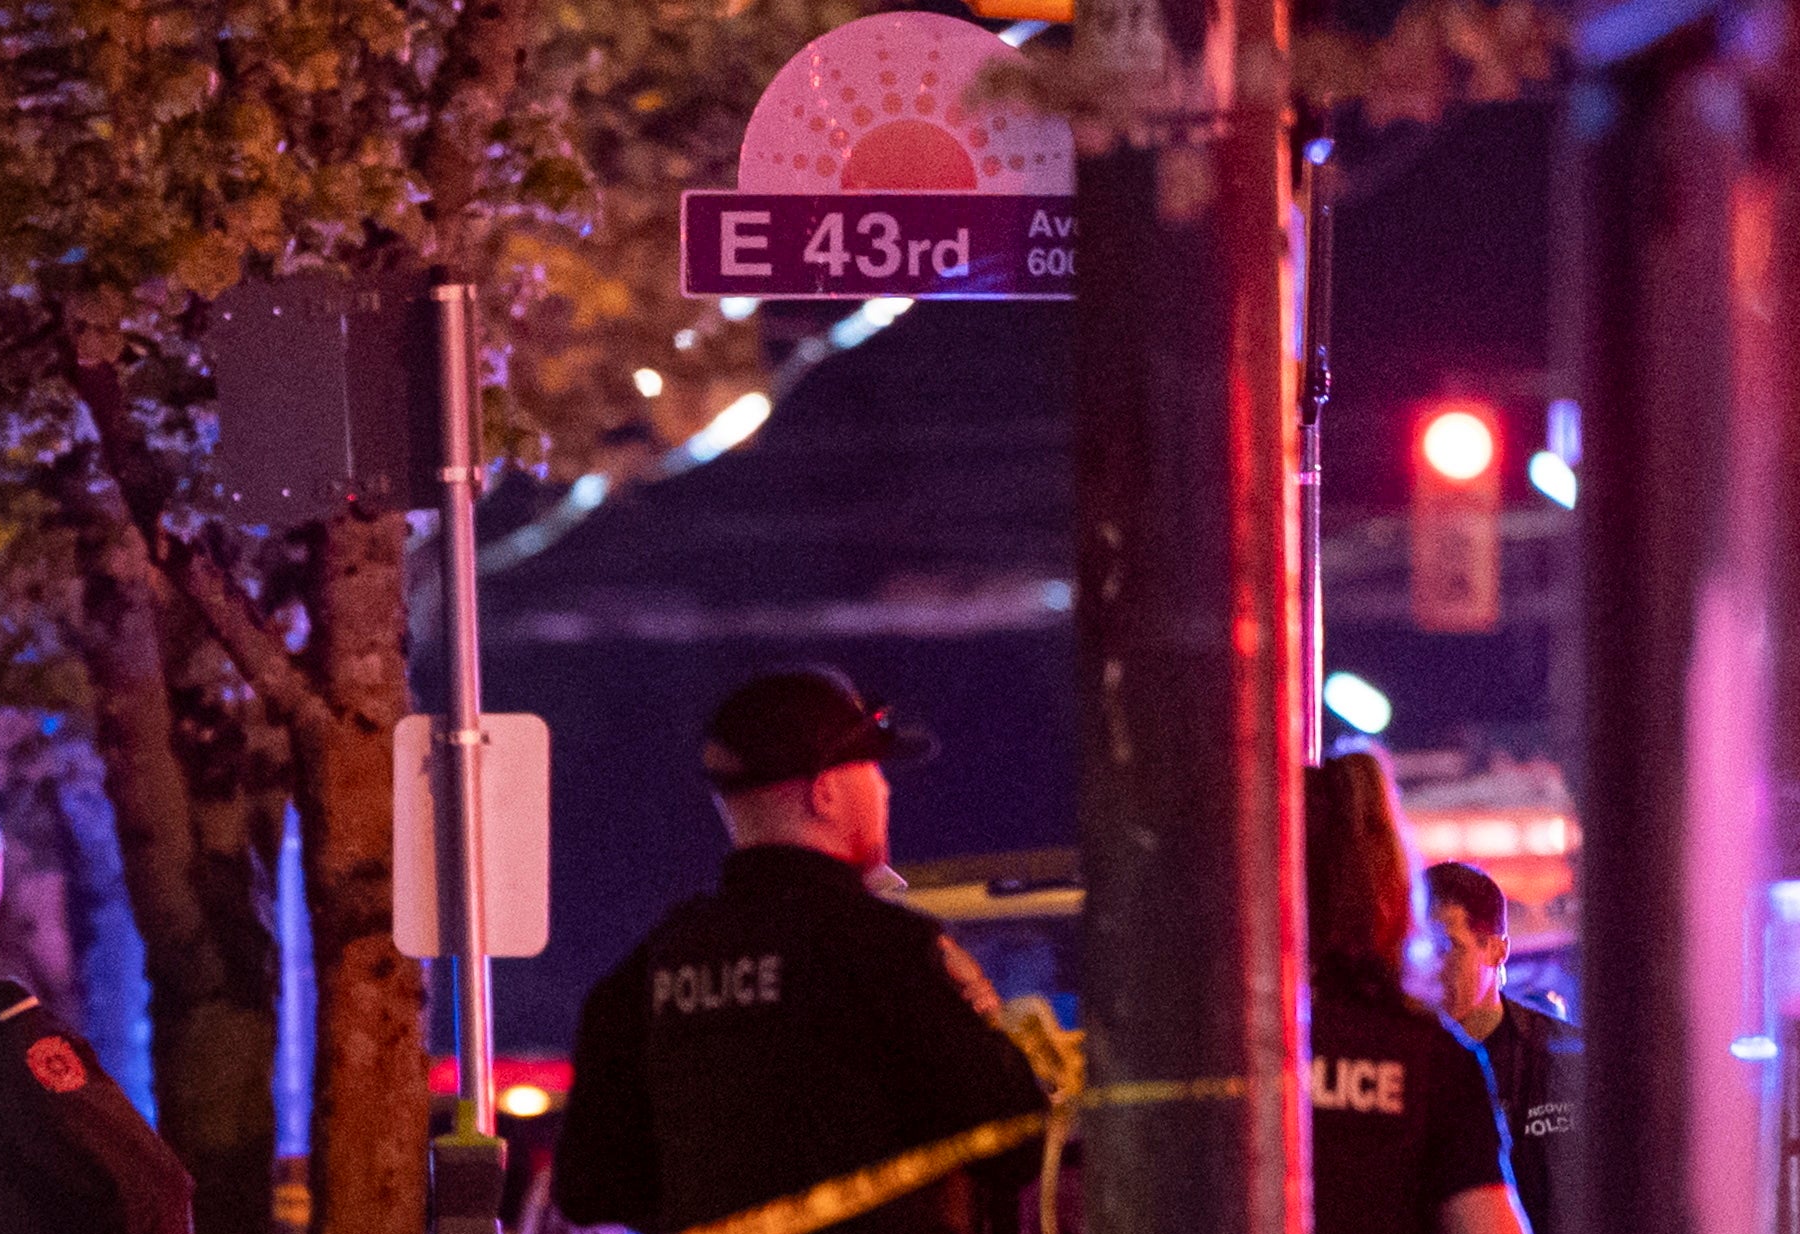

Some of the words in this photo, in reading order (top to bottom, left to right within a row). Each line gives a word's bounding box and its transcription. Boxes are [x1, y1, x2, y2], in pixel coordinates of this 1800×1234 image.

[719, 211, 773, 277] E
[803, 211, 971, 279] 43rd
[1028, 209, 1077, 238] Av
[651, 954, 782, 1016] POLICE
[1310, 1055, 1405, 1115] LICE
